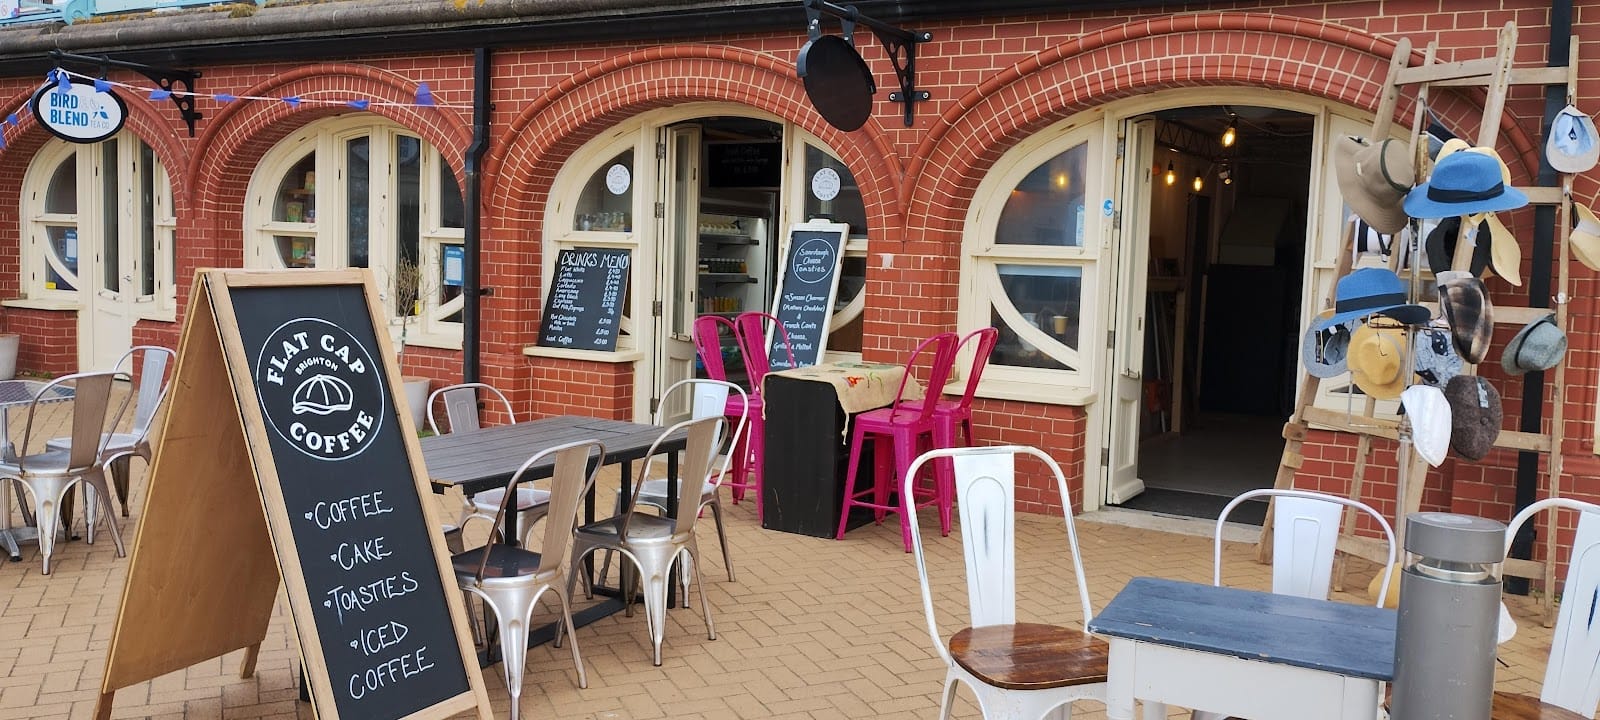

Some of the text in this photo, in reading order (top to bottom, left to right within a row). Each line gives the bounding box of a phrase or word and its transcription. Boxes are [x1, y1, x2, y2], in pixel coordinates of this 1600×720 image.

[50, 92, 78, 110] BIRD
[50, 109, 88, 127] BLEND
[561, 252, 598, 267] DRINKS
[796, 264, 826, 272] Toasties
[267, 332, 365, 386] FLAT CAP
[295, 357, 338, 375] BRIGHTON
[290, 410, 374, 453] COFFEE
[314, 491, 394, 529] COFFEE
[338, 537, 392, 570] CAKE
[327, 572, 418, 625] TOASTIES
[360, 621, 408, 656] ICED
[349, 646, 435, 700] COFFEE
